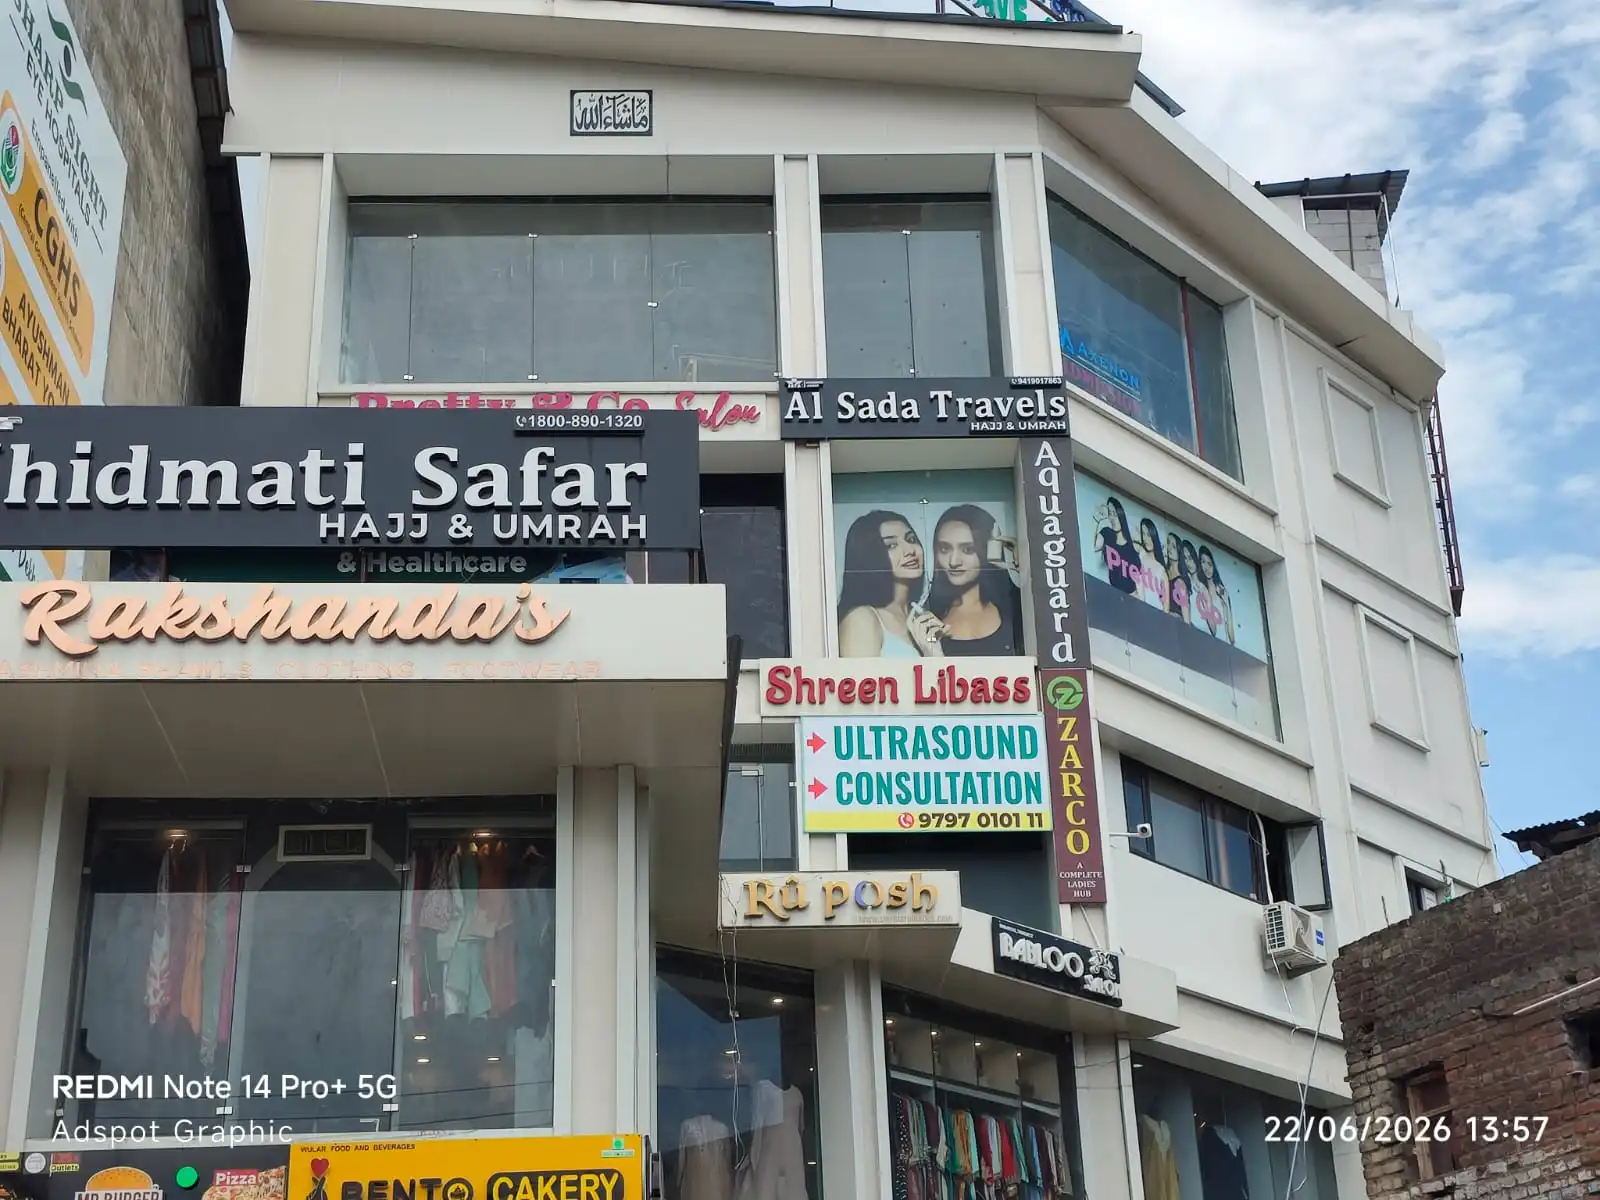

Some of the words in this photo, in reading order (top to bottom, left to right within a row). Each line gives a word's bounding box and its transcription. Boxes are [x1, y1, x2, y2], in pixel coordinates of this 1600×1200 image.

[26, 50, 44, 107] EYE
[45, 99, 91, 226] HOSPITALS
[65, 113, 108, 231] SIGHT
[34, 187, 81, 317] CGHS
[2, 295, 41, 387] BHARAT
[19, 292, 70, 406] AYUSHMAN
[528, 414, 643, 429] 1800-890-1320
[784, 391, 823, 420] Al
[837, 391, 920, 420] Sada
[929, 389, 1066, 420] Travels
[971, 421, 1003, 431] HAJJ
[1006, 421, 1015, 431] &
[1018, 421, 1066, 431] UMRAH
[0, 441, 366, 508] hidmati
[411, 445, 648, 508] Safar
[319, 513, 429, 540] HAJJ
[447, 513, 474, 540] &
[493, 514, 647, 541] UMRAH
[337, 553, 357, 573] &
[368, 552, 527, 573] Healthcare
[1034, 440, 1076, 663] Aquaguard
[20, 580, 572, 656] Rakshanda's
[765, 665, 899, 705] Shreen
[912, 664, 1031, 704] Libass
[833, 725, 1038, 760] ULTRASOUND
[836, 770, 1042, 805] CONSULTATION
[1057, 717, 1090, 855] ZARCO
[918, 813, 971, 828] 9797
[977, 813, 1021, 828] 0101
[1027, 812, 1043, 828] 11
[1060, 871, 1102, 879] COMPLETE
[822, 873, 938, 921] posh
[330, 1144, 351, 1152] FOOD
[354, 1144, 370, 1152] AND
[373, 1143, 416, 1151] BEVERAGES
[215, 1171, 257, 1186] Pizza
[341, 1177, 474, 1200] BENTO
[492, 1172, 619, 1200] CAKERY
